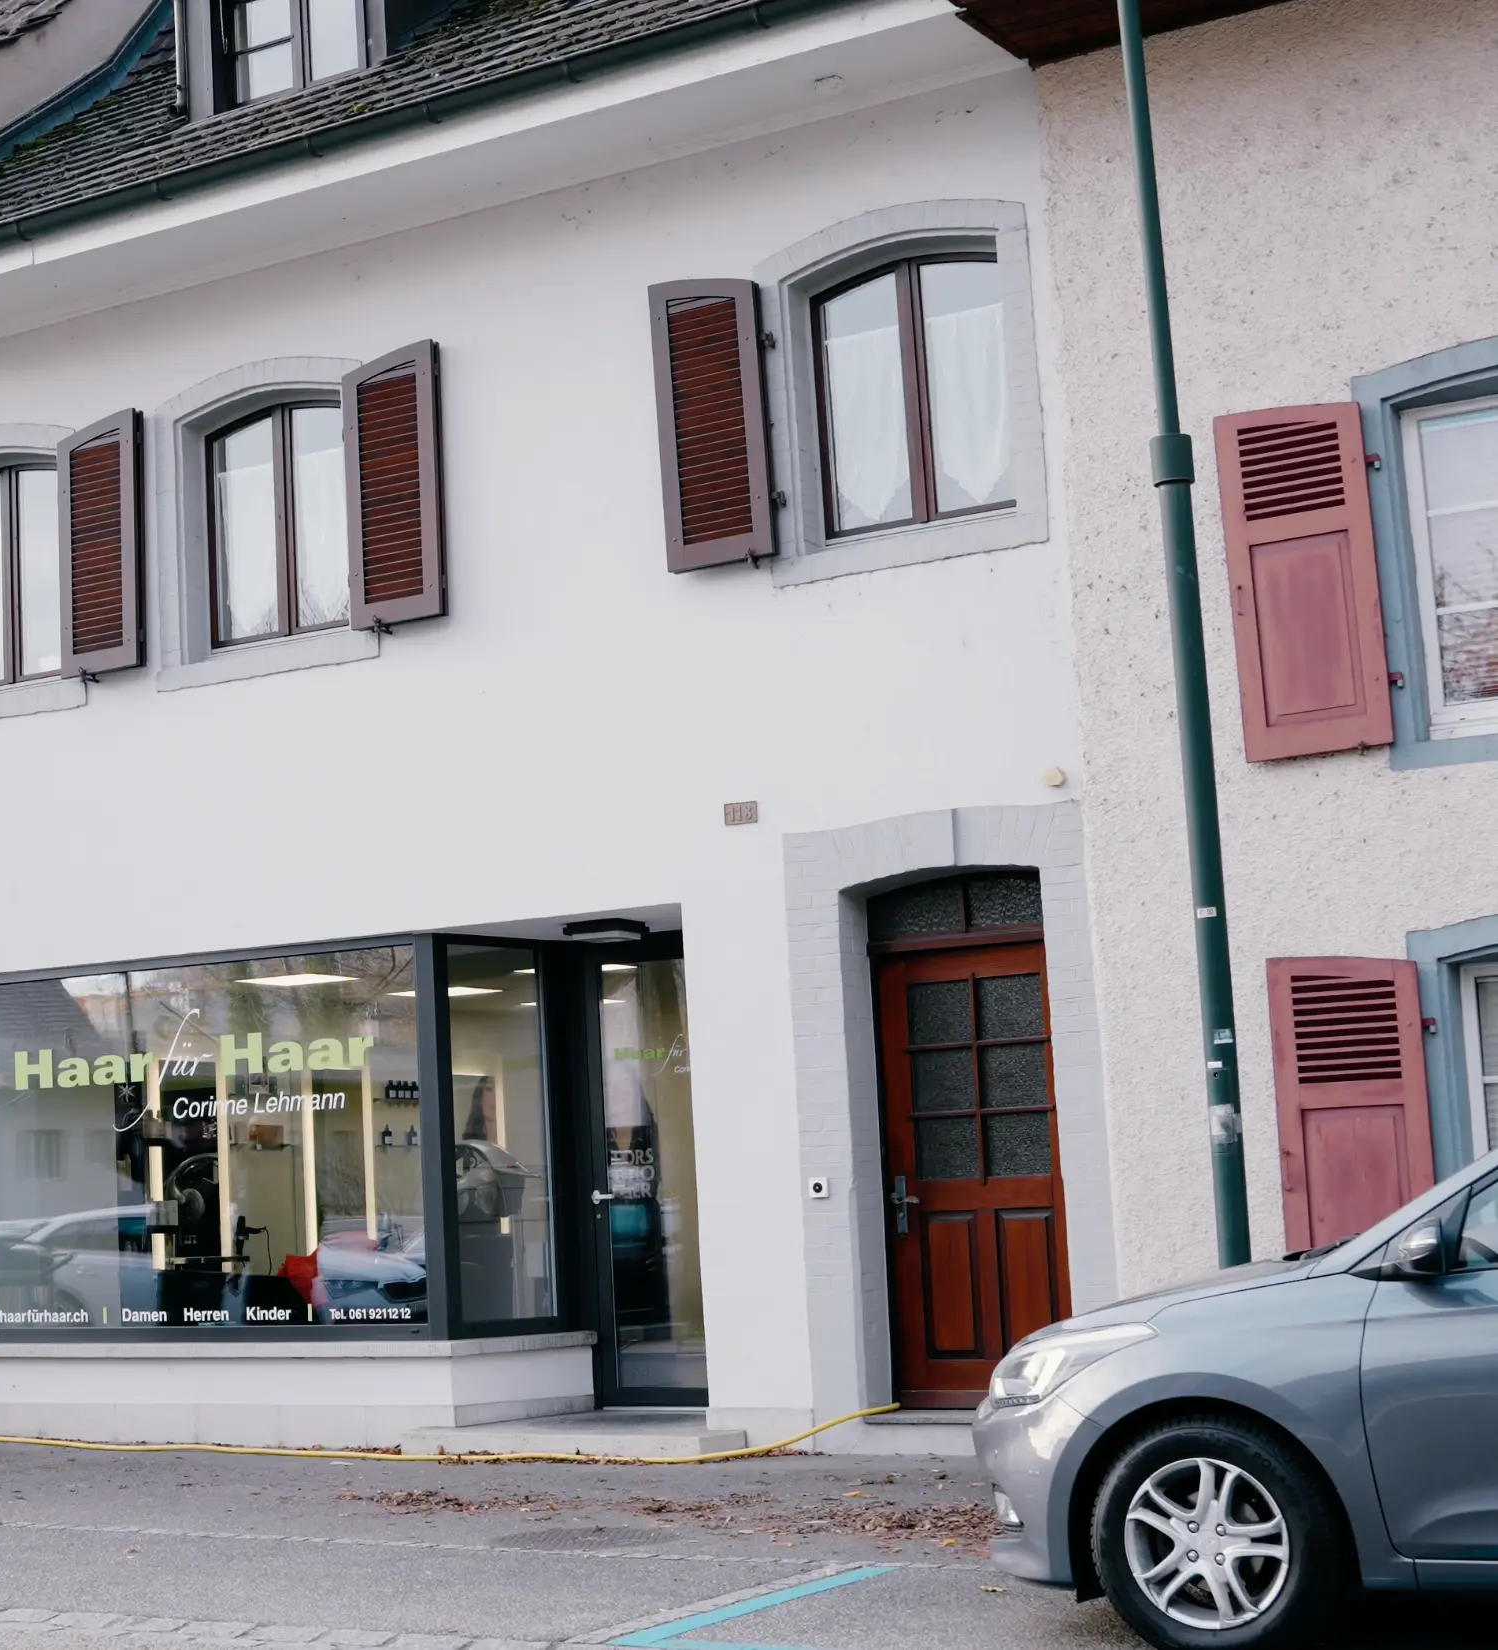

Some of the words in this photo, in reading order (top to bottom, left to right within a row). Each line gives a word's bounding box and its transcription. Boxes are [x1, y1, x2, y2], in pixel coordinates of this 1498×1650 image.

[14, 1049, 153, 1091] Haar
[113, 1008, 213, 1132] für
[220, 1032, 374, 1076] Haar
[173, 1094, 247, 1119] Corinne
[254, 1092, 345, 1114] Lehmann
[0, 1308, 89, 1323] haarfürhaar.ch
[122, 1308, 168, 1322] Damen
[183, 1307, 229, 1322] Herren
[246, 1306, 292, 1321] Kinder
[329, 1308, 347, 1320] Tel.
